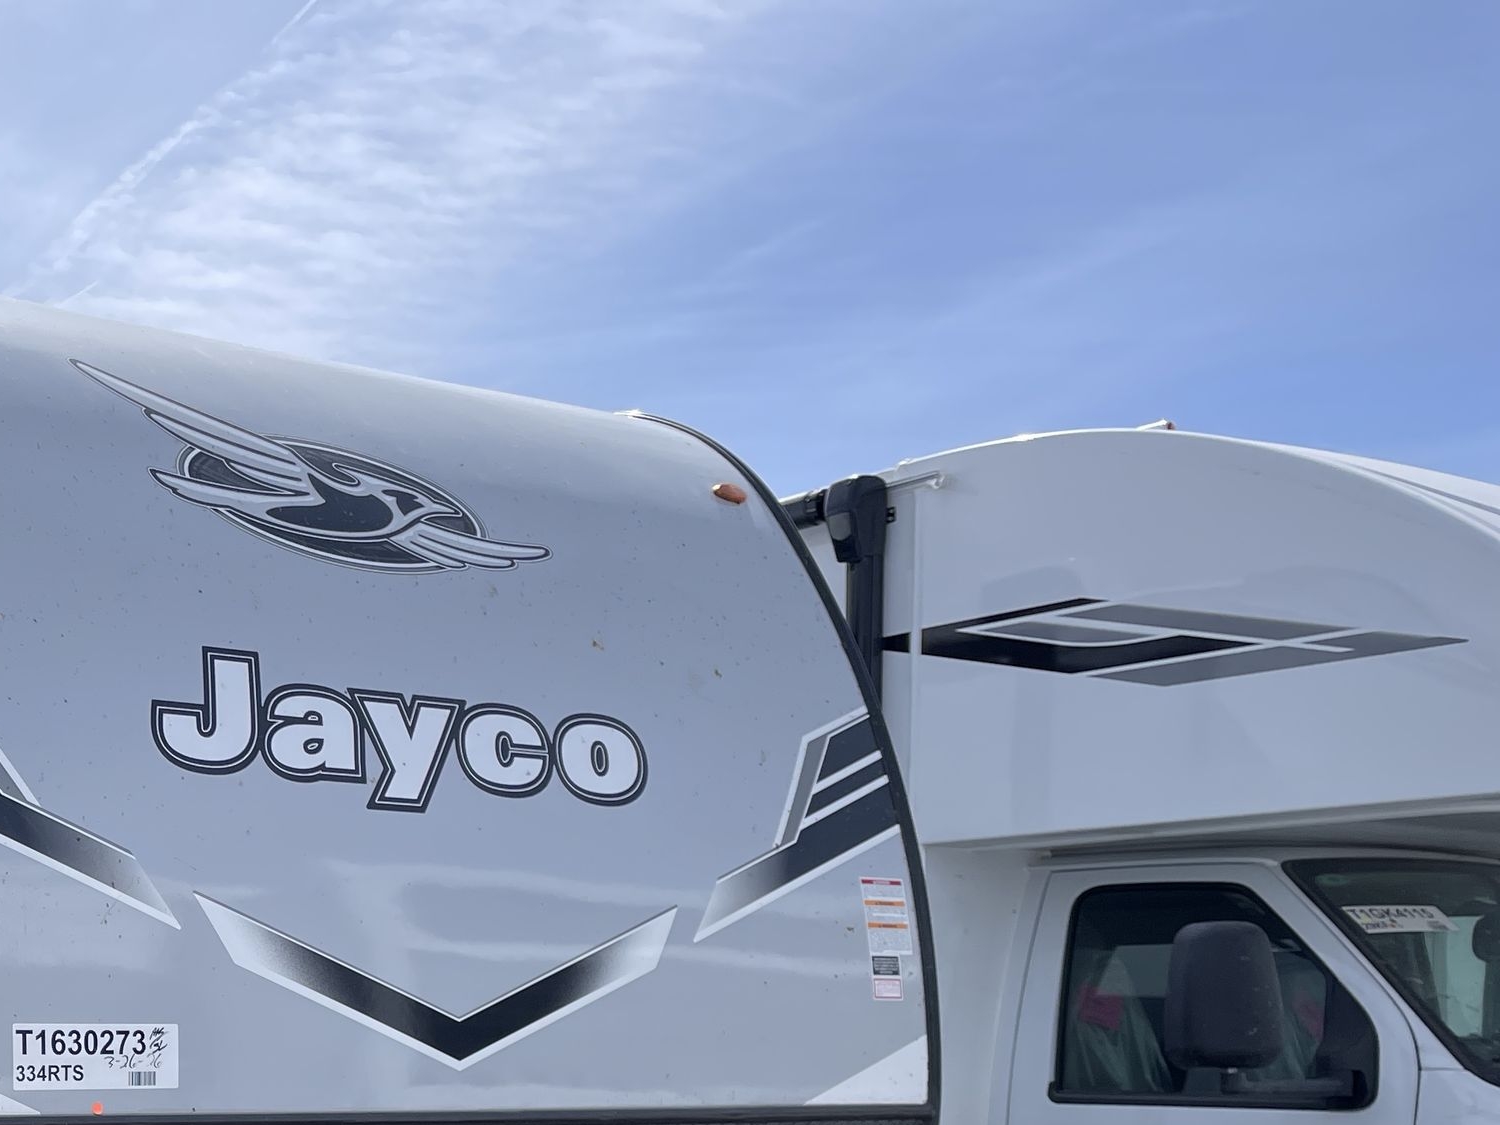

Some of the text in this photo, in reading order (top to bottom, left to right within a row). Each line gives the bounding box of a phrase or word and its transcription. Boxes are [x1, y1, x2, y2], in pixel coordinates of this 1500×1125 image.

[150, 645, 648, 813] Jayco
[15, 1029, 147, 1055] T1630273
[16, 1065, 84, 1082] 334RTS
